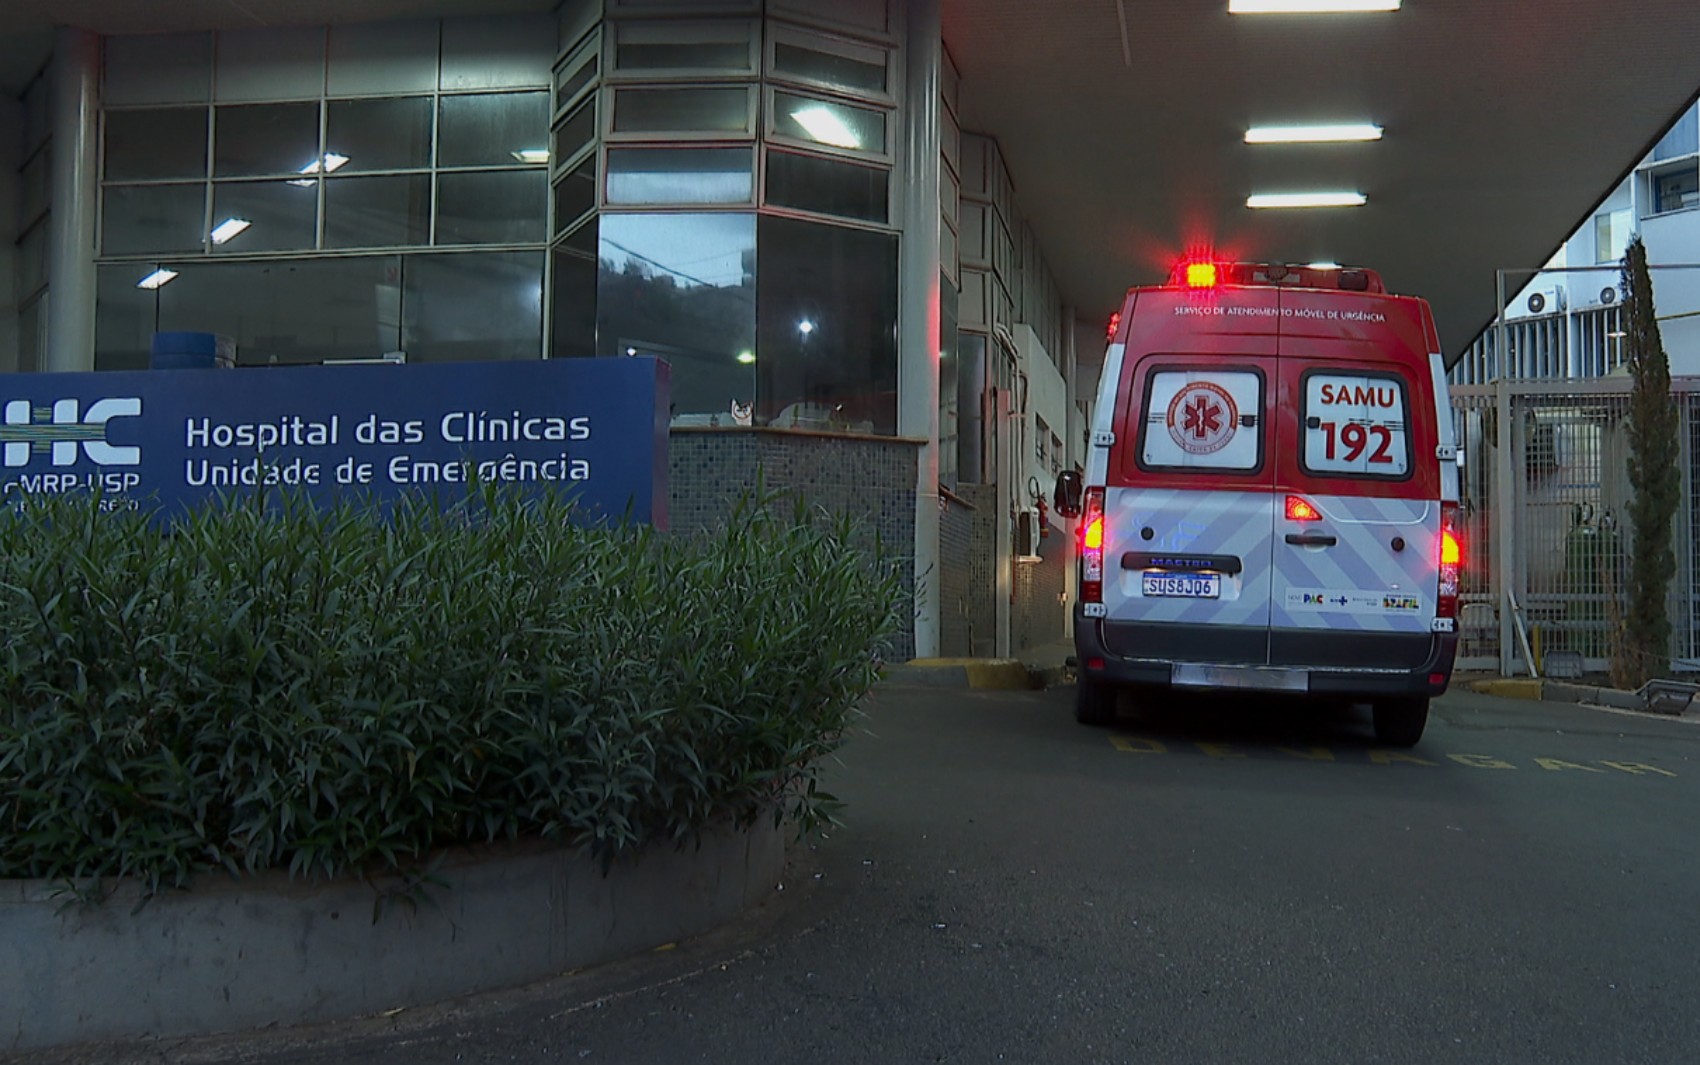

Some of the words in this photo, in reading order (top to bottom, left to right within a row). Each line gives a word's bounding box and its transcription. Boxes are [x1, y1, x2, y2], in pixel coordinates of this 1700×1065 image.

[1174, 306, 1212, 317] SERVIÇO
[1213, 306, 1227, 316] DE
[1227, 307, 1292, 318] ATENDIMENTO
[1294, 307, 1325, 319] MÓVEL
[1327, 310, 1340, 320] DE
[1341, 309, 1386, 322] URGÊNCIA
[1320, 383, 1395, 408] SAMU
[4, 397, 142, 467] HC
[186, 414, 338, 453] Hospital
[354, 413, 424, 444] das
[440, 410, 591, 442] Clínicas
[1320, 421, 1393, 464] 192
[186, 457, 320, 486] Unidade
[335, 456, 373, 485] de
[388, 451, 591, 484] Emergência
[1303, 593, 1323, 604] PAC
